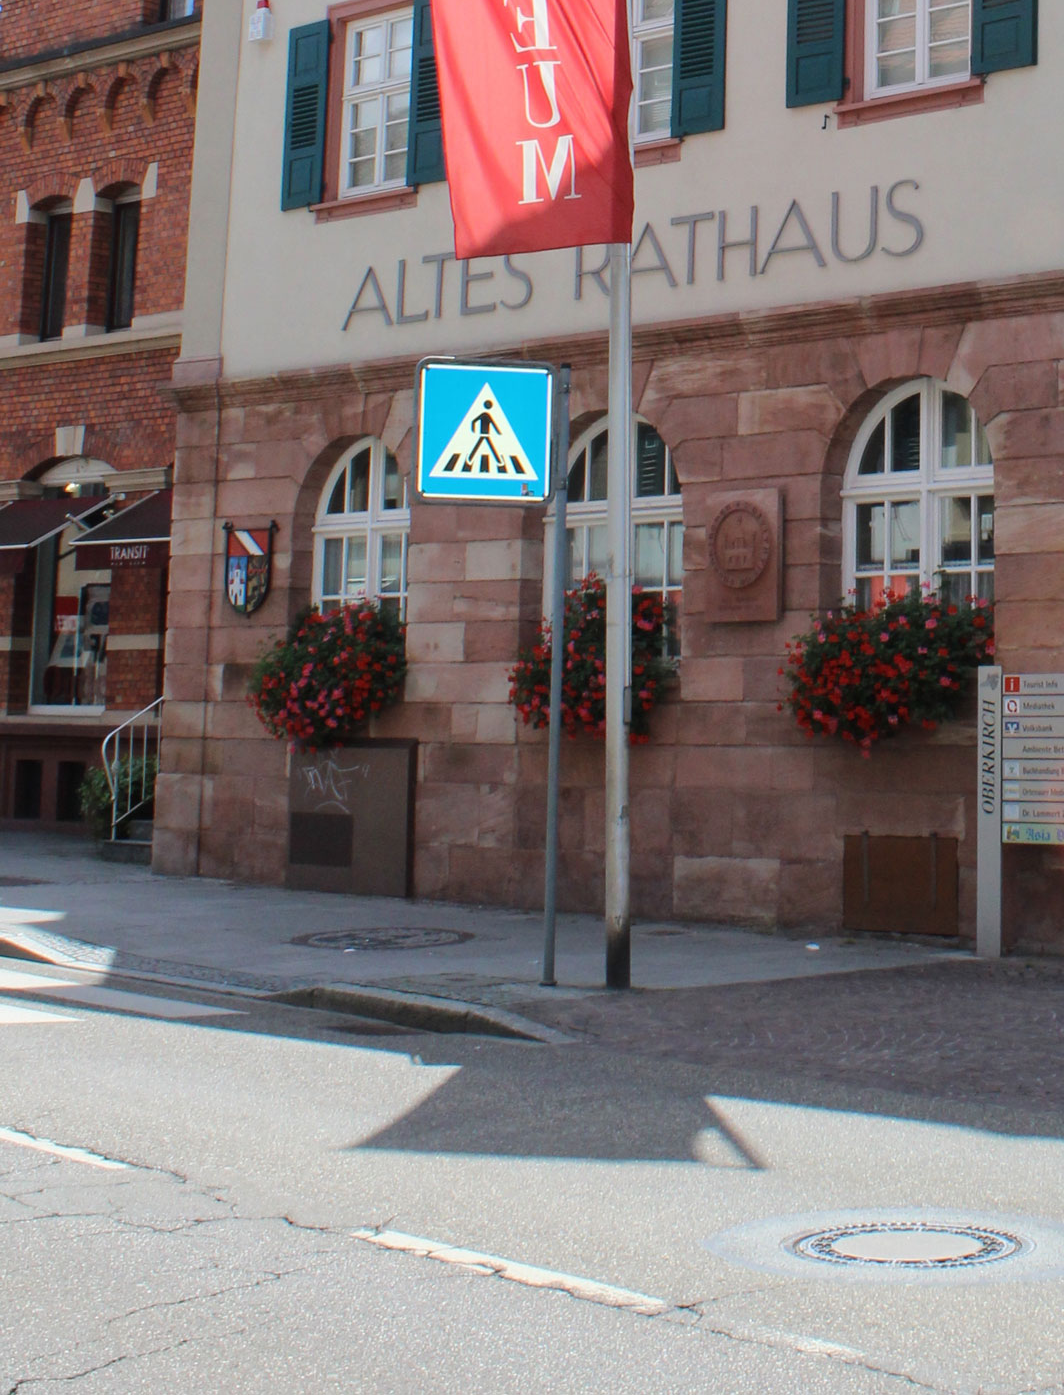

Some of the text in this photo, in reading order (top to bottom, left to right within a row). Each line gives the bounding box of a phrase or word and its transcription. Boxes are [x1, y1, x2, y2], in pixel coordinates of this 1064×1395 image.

[341, 250, 533, 332] ALTES
[110, 545, 148, 559] TRANSIT
[1023, 680, 1044, 689] Tourist
[1045, 680, 1058, 688] Info
[1023, 702, 1055, 710] Mediathek
[1022, 724, 1053, 732] Volksbank
[1022, 745, 1051, 753] Ambiente
[982, 699, 996, 814] OBERKIRCH
[1026, 828, 1051, 841] Asia
